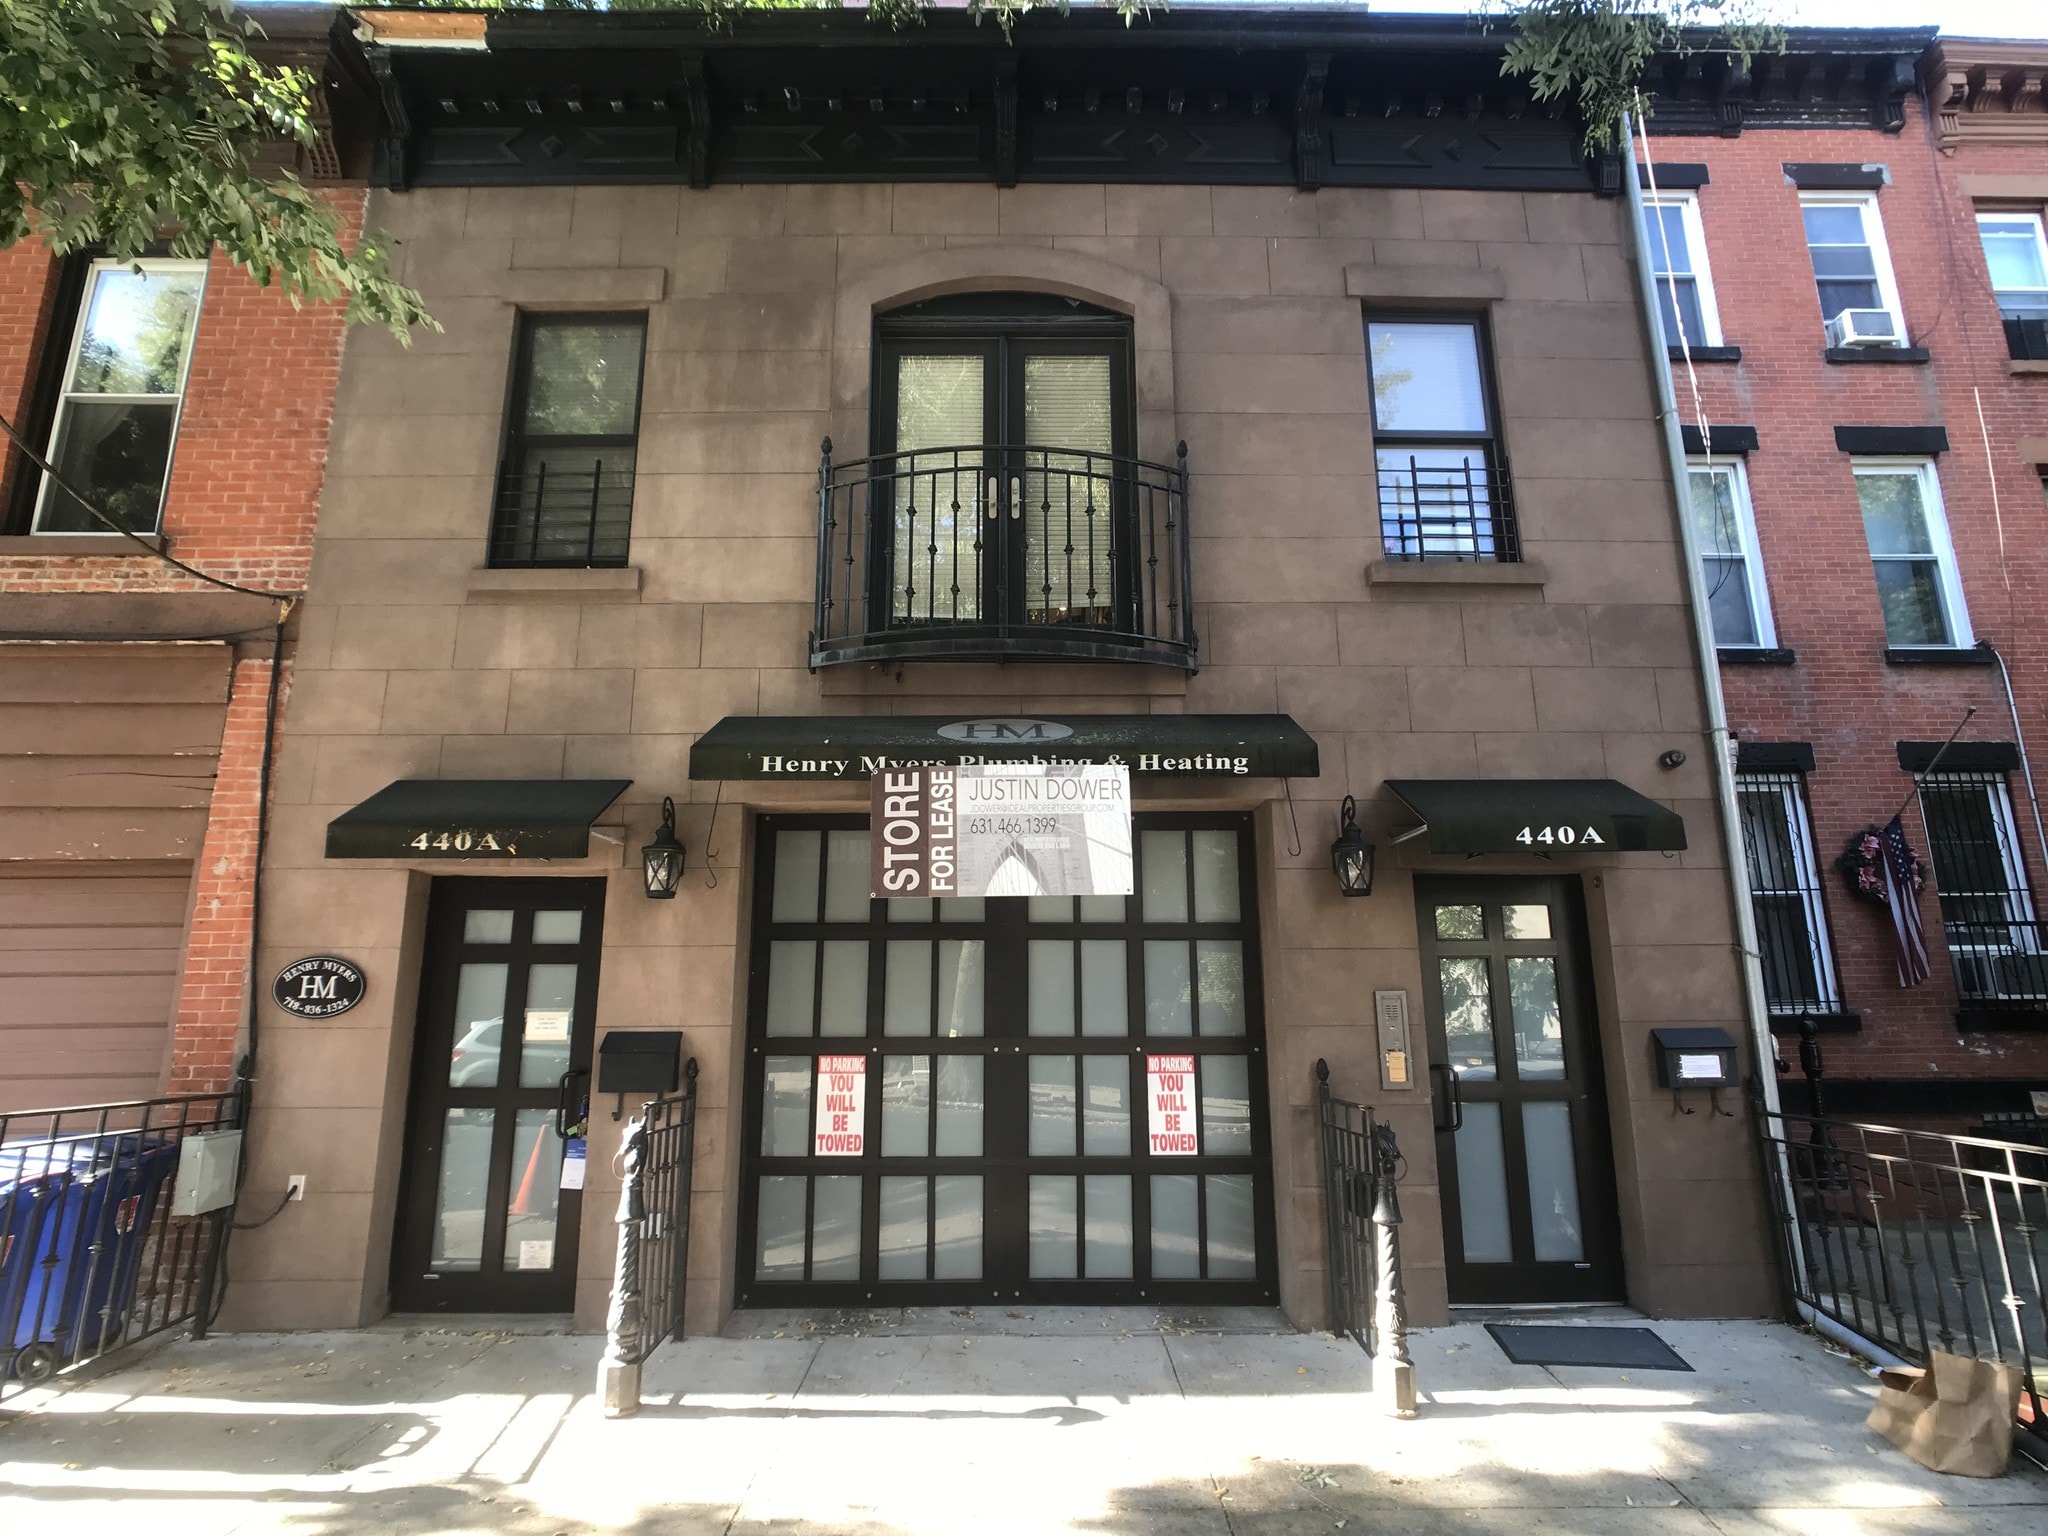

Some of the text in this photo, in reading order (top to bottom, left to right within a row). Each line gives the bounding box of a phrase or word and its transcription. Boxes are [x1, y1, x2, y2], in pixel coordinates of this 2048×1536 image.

[960, 723, 1051, 740] HM
[760, 755, 849, 777] Henry
[1104, 754, 1126, 766] &
[1138, 753, 1249, 775] Heating
[969, 778, 1123, 801] JUSTIN DOWER
[883, 771, 920, 891] STORE
[930, 770, 954, 891] FOR LEASE
[970, 817, 1057, 834] 631.466.1399
[410, 832, 502, 851] 440A
[1515, 825, 1606, 845] 440A
[282, 961, 358, 983] HENRY MYERS
[298, 975, 339, 999] HM
[283, 996, 350, 1014] 718-836-1324
[820, 1057, 865, 1072] NO PARKING
[1148, 1057, 1193, 1072] NO PARKING
[830, 1075, 854, 1092] YOU
[1159, 1074, 1184, 1092] YOU
[826, 1094, 856, 1112] WILL
[1157, 1094, 1187, 1112] WILL
[832, 1114, 848, 1132] BE
[1165, 1114, 1181, 1131] BE
[817, 1134, 862, 1152] TOWED
[1150, 1134, 1196, 1151] TOWED
